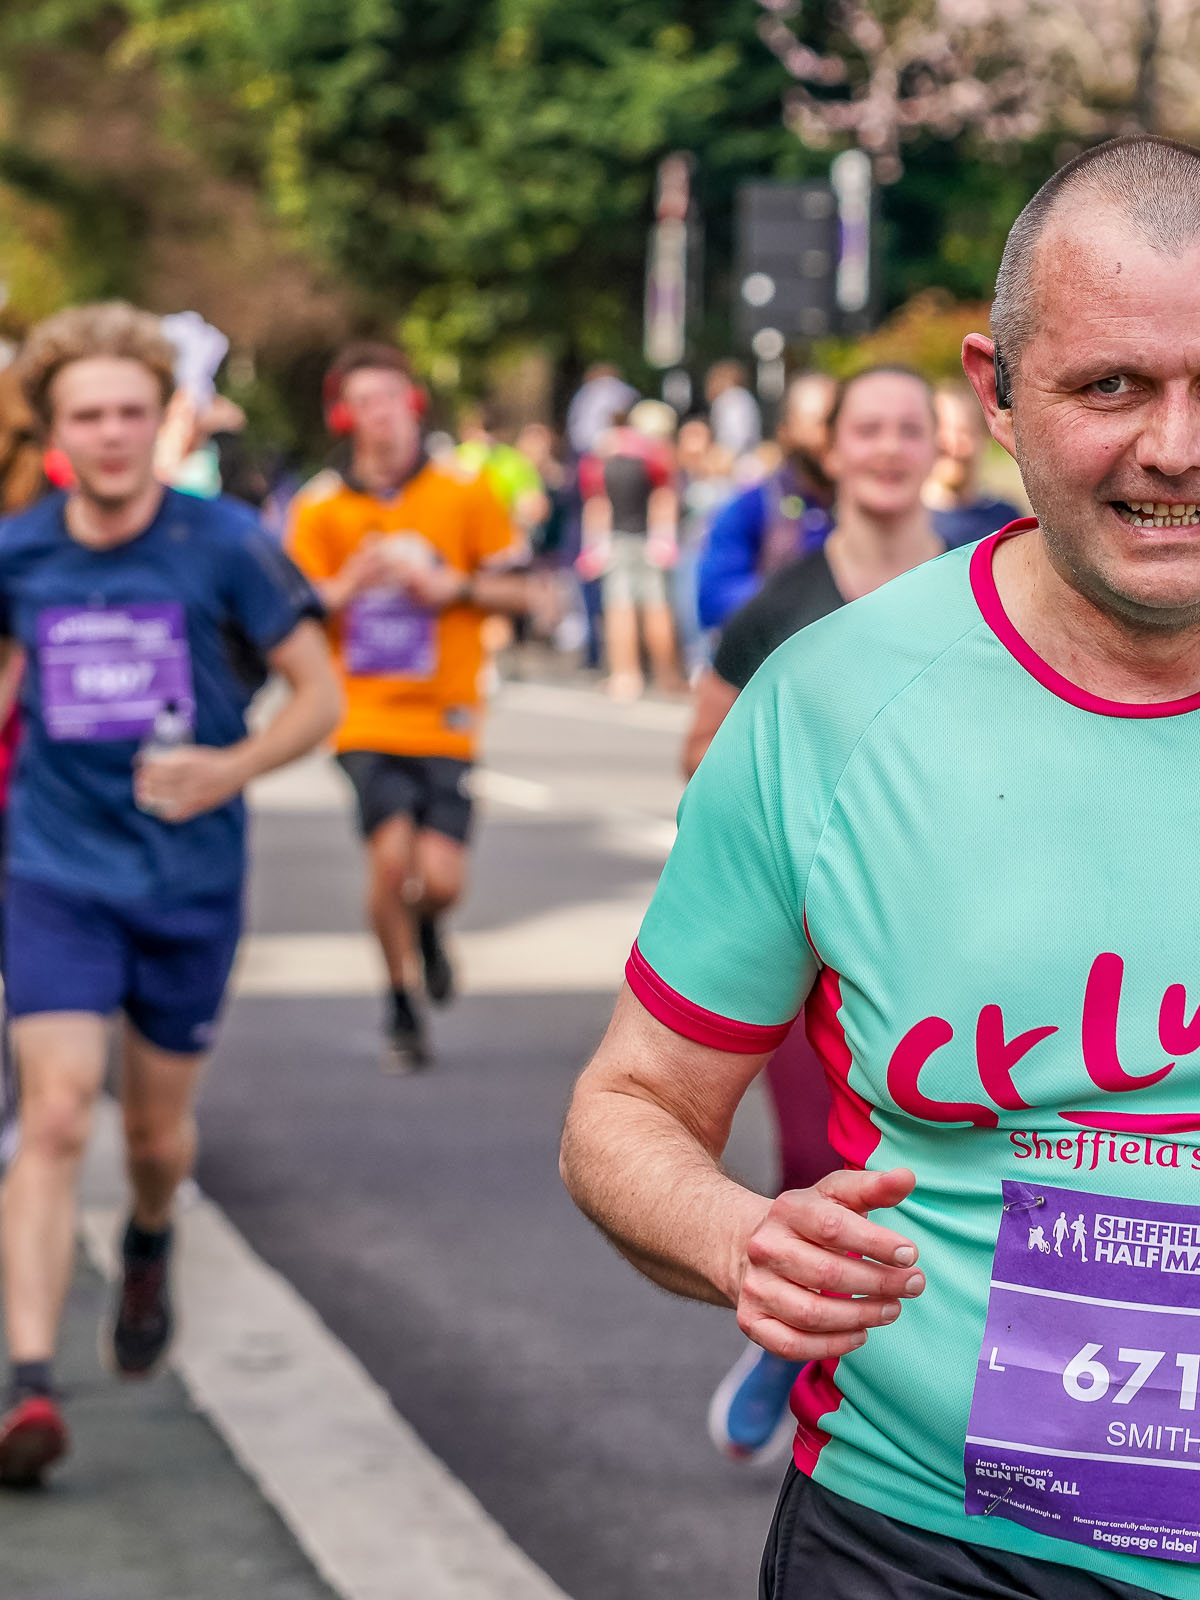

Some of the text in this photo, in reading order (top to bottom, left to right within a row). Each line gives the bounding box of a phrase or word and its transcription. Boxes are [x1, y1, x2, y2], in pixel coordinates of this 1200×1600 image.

[1094, 1240, 1161, 1269] HALF
[988, 1346, 1006, 1372] L
[975, 1458, 1054, 1478] Jane Tomlinson's
[975, 1467, 1080, 1496] RUN FOR ALL
[977, 1488, 989, 1498] Pull
[1009, 1498, 1026, 1510] label
[1026, 1503, 1051, 1518] through
[1051, 1512, 1061, 1520] slit
[1073, 1515, 1095, 1526] Please
[1095, 1519, 1109, 1527] tear
[1110, 1521, 1139, 1532] carefully
[1139, 1524, 1159, 1534] along
[1159, 1526, 1170, 1534] the
[1092, 1529, 1198, 1554] Baggage label
